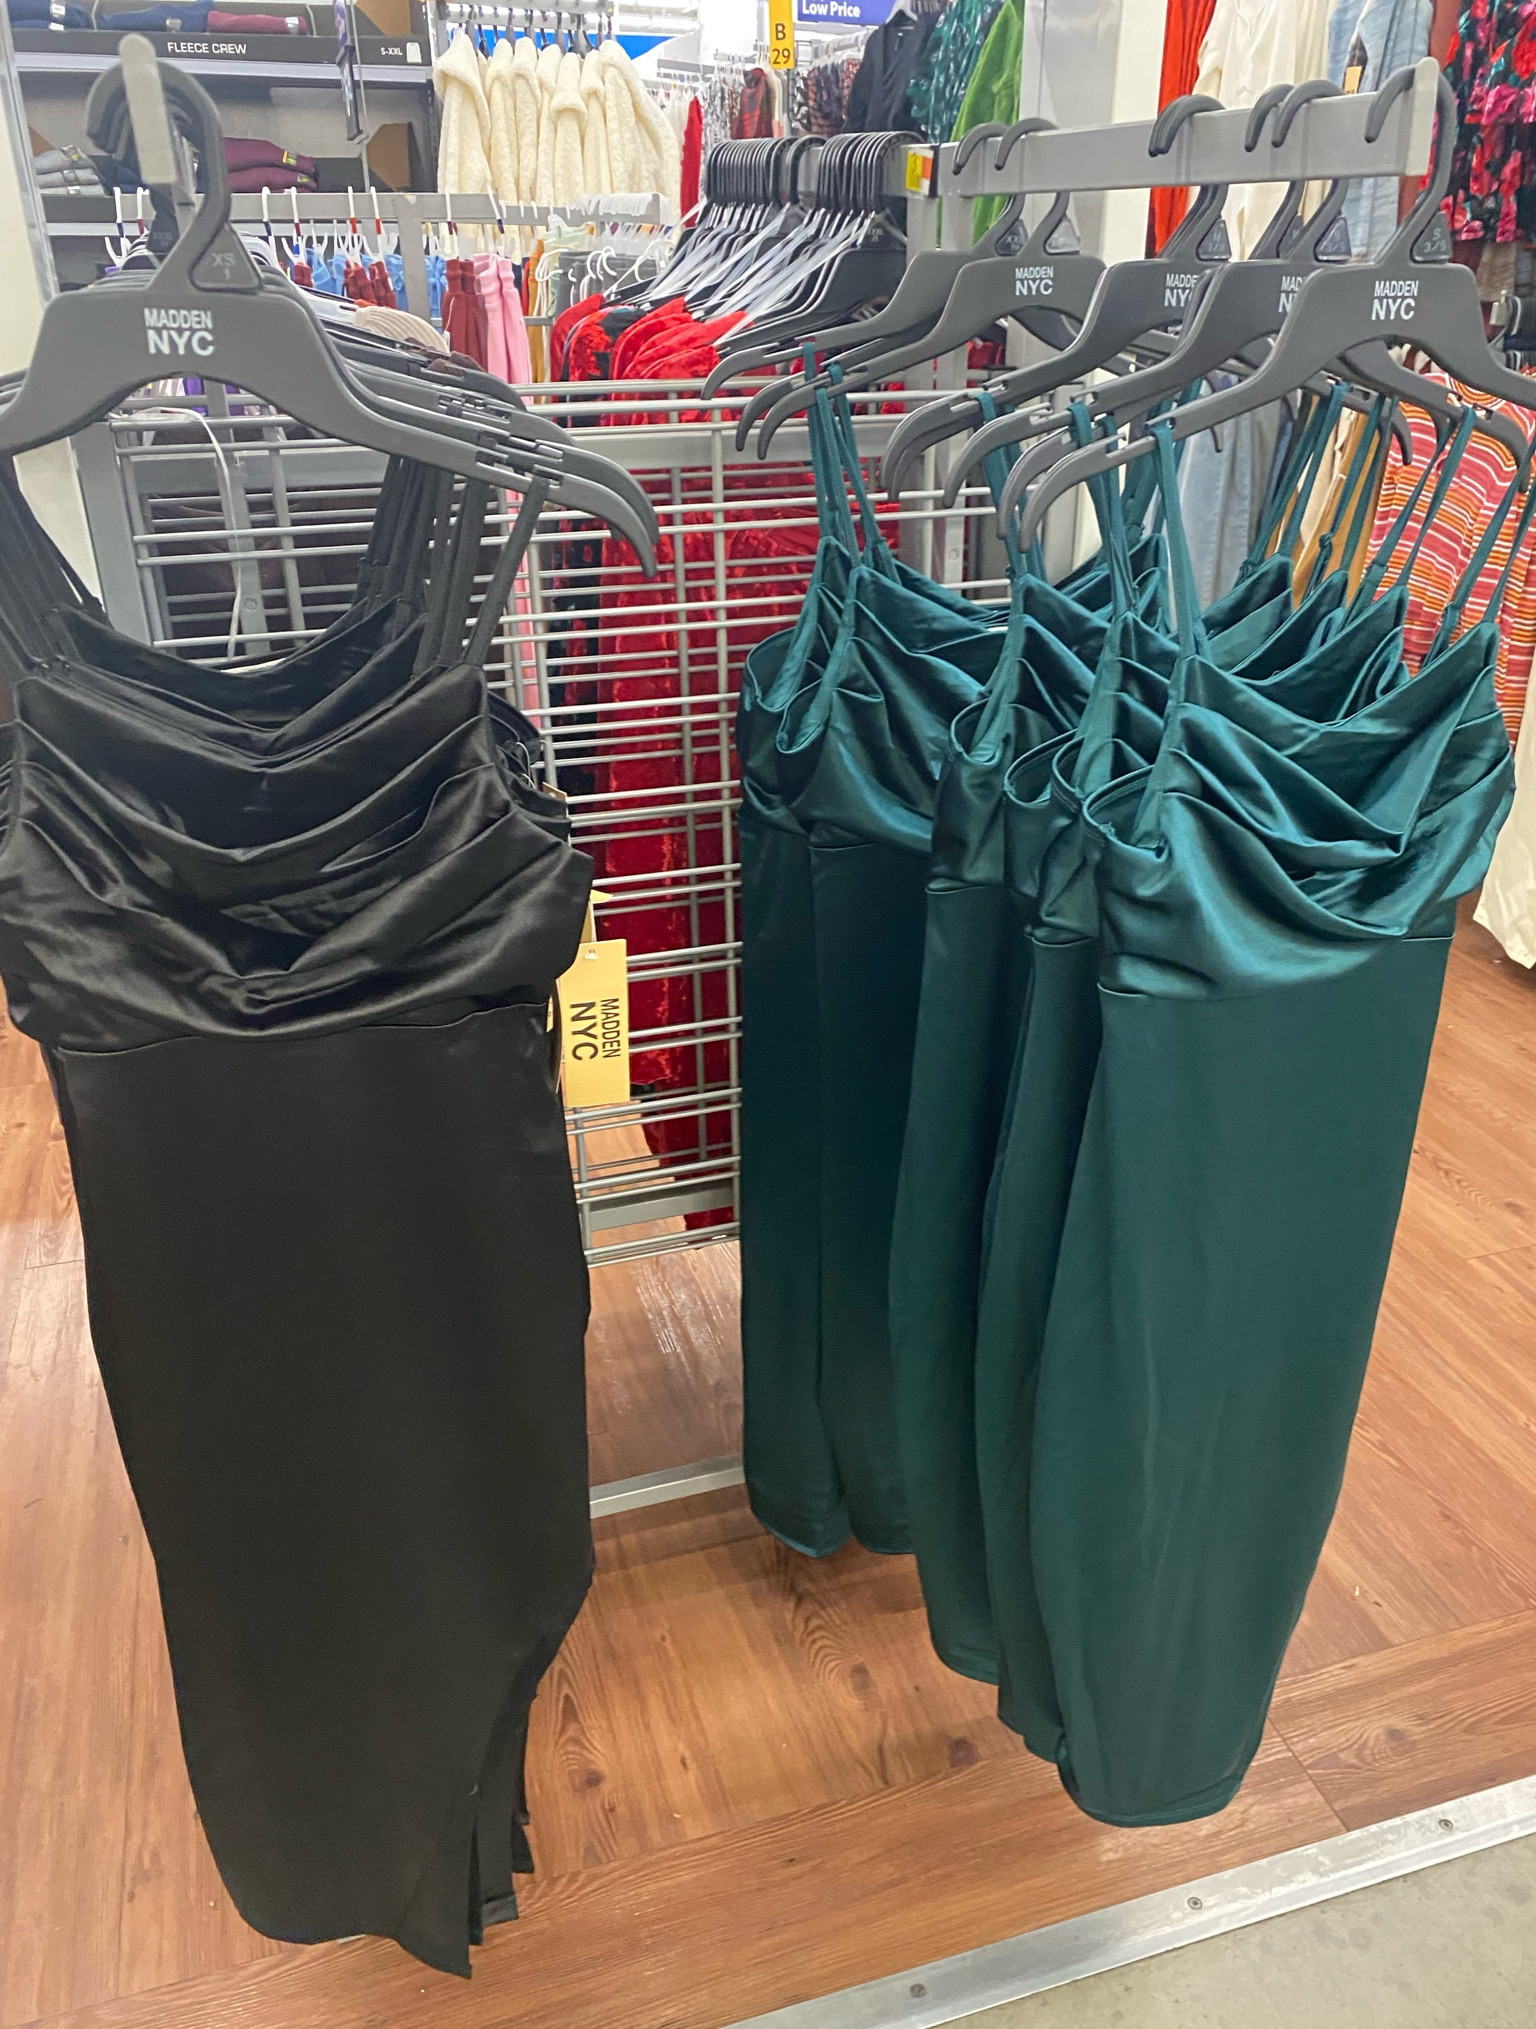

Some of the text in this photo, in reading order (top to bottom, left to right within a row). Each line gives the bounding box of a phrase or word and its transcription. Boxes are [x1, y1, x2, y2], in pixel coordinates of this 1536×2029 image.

[802, 0, 861, 18] Low Price
[774, 23, 786, 41] B
[167, 42, 247, 55] FLEECE CREW
[380, 47, 403, 56] S-XXL
[772, 48, 791, 65] 29
[211, 252, 235, 267] XS
[1015, 266, 1054, 279] MADDEN
[1165, 272, 1199, 288] MADDE
[1015, 279, 1053, 296] NYC
[1374, 280, 1419, 297] MADDEN
[1164, 288, 1192, 307] NY
[143, 307, 213, 329] MADDEN
[1371, 298, 1416, 321] NYC
[146, 329, 214, 356] NYC
[570, 1001, 599, 1061] NYC
[601, 998, 621, 1058] MADDEN
